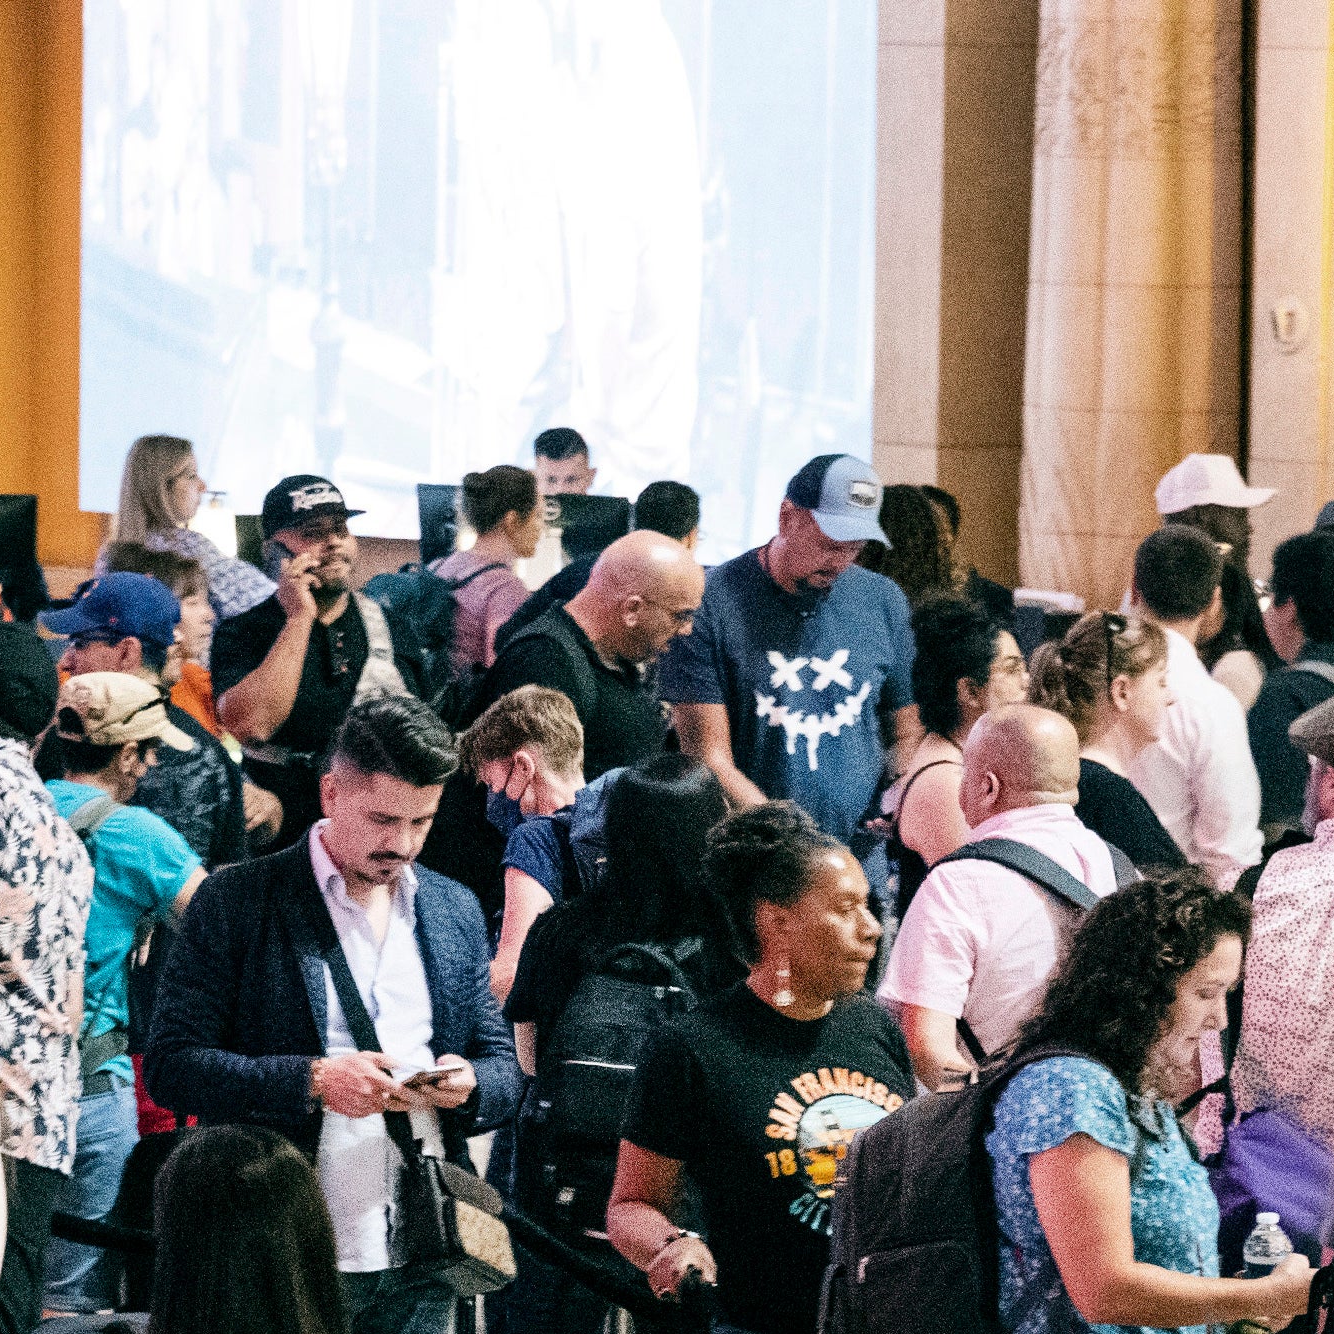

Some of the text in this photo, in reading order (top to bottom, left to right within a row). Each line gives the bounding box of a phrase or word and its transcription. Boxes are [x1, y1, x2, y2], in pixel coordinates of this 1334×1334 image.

[765, 1067, 904, 1141] SAN FRANCISC
[765, 1149, 797, 1178] 18
[789, 1193, 833, 1236] CIT
